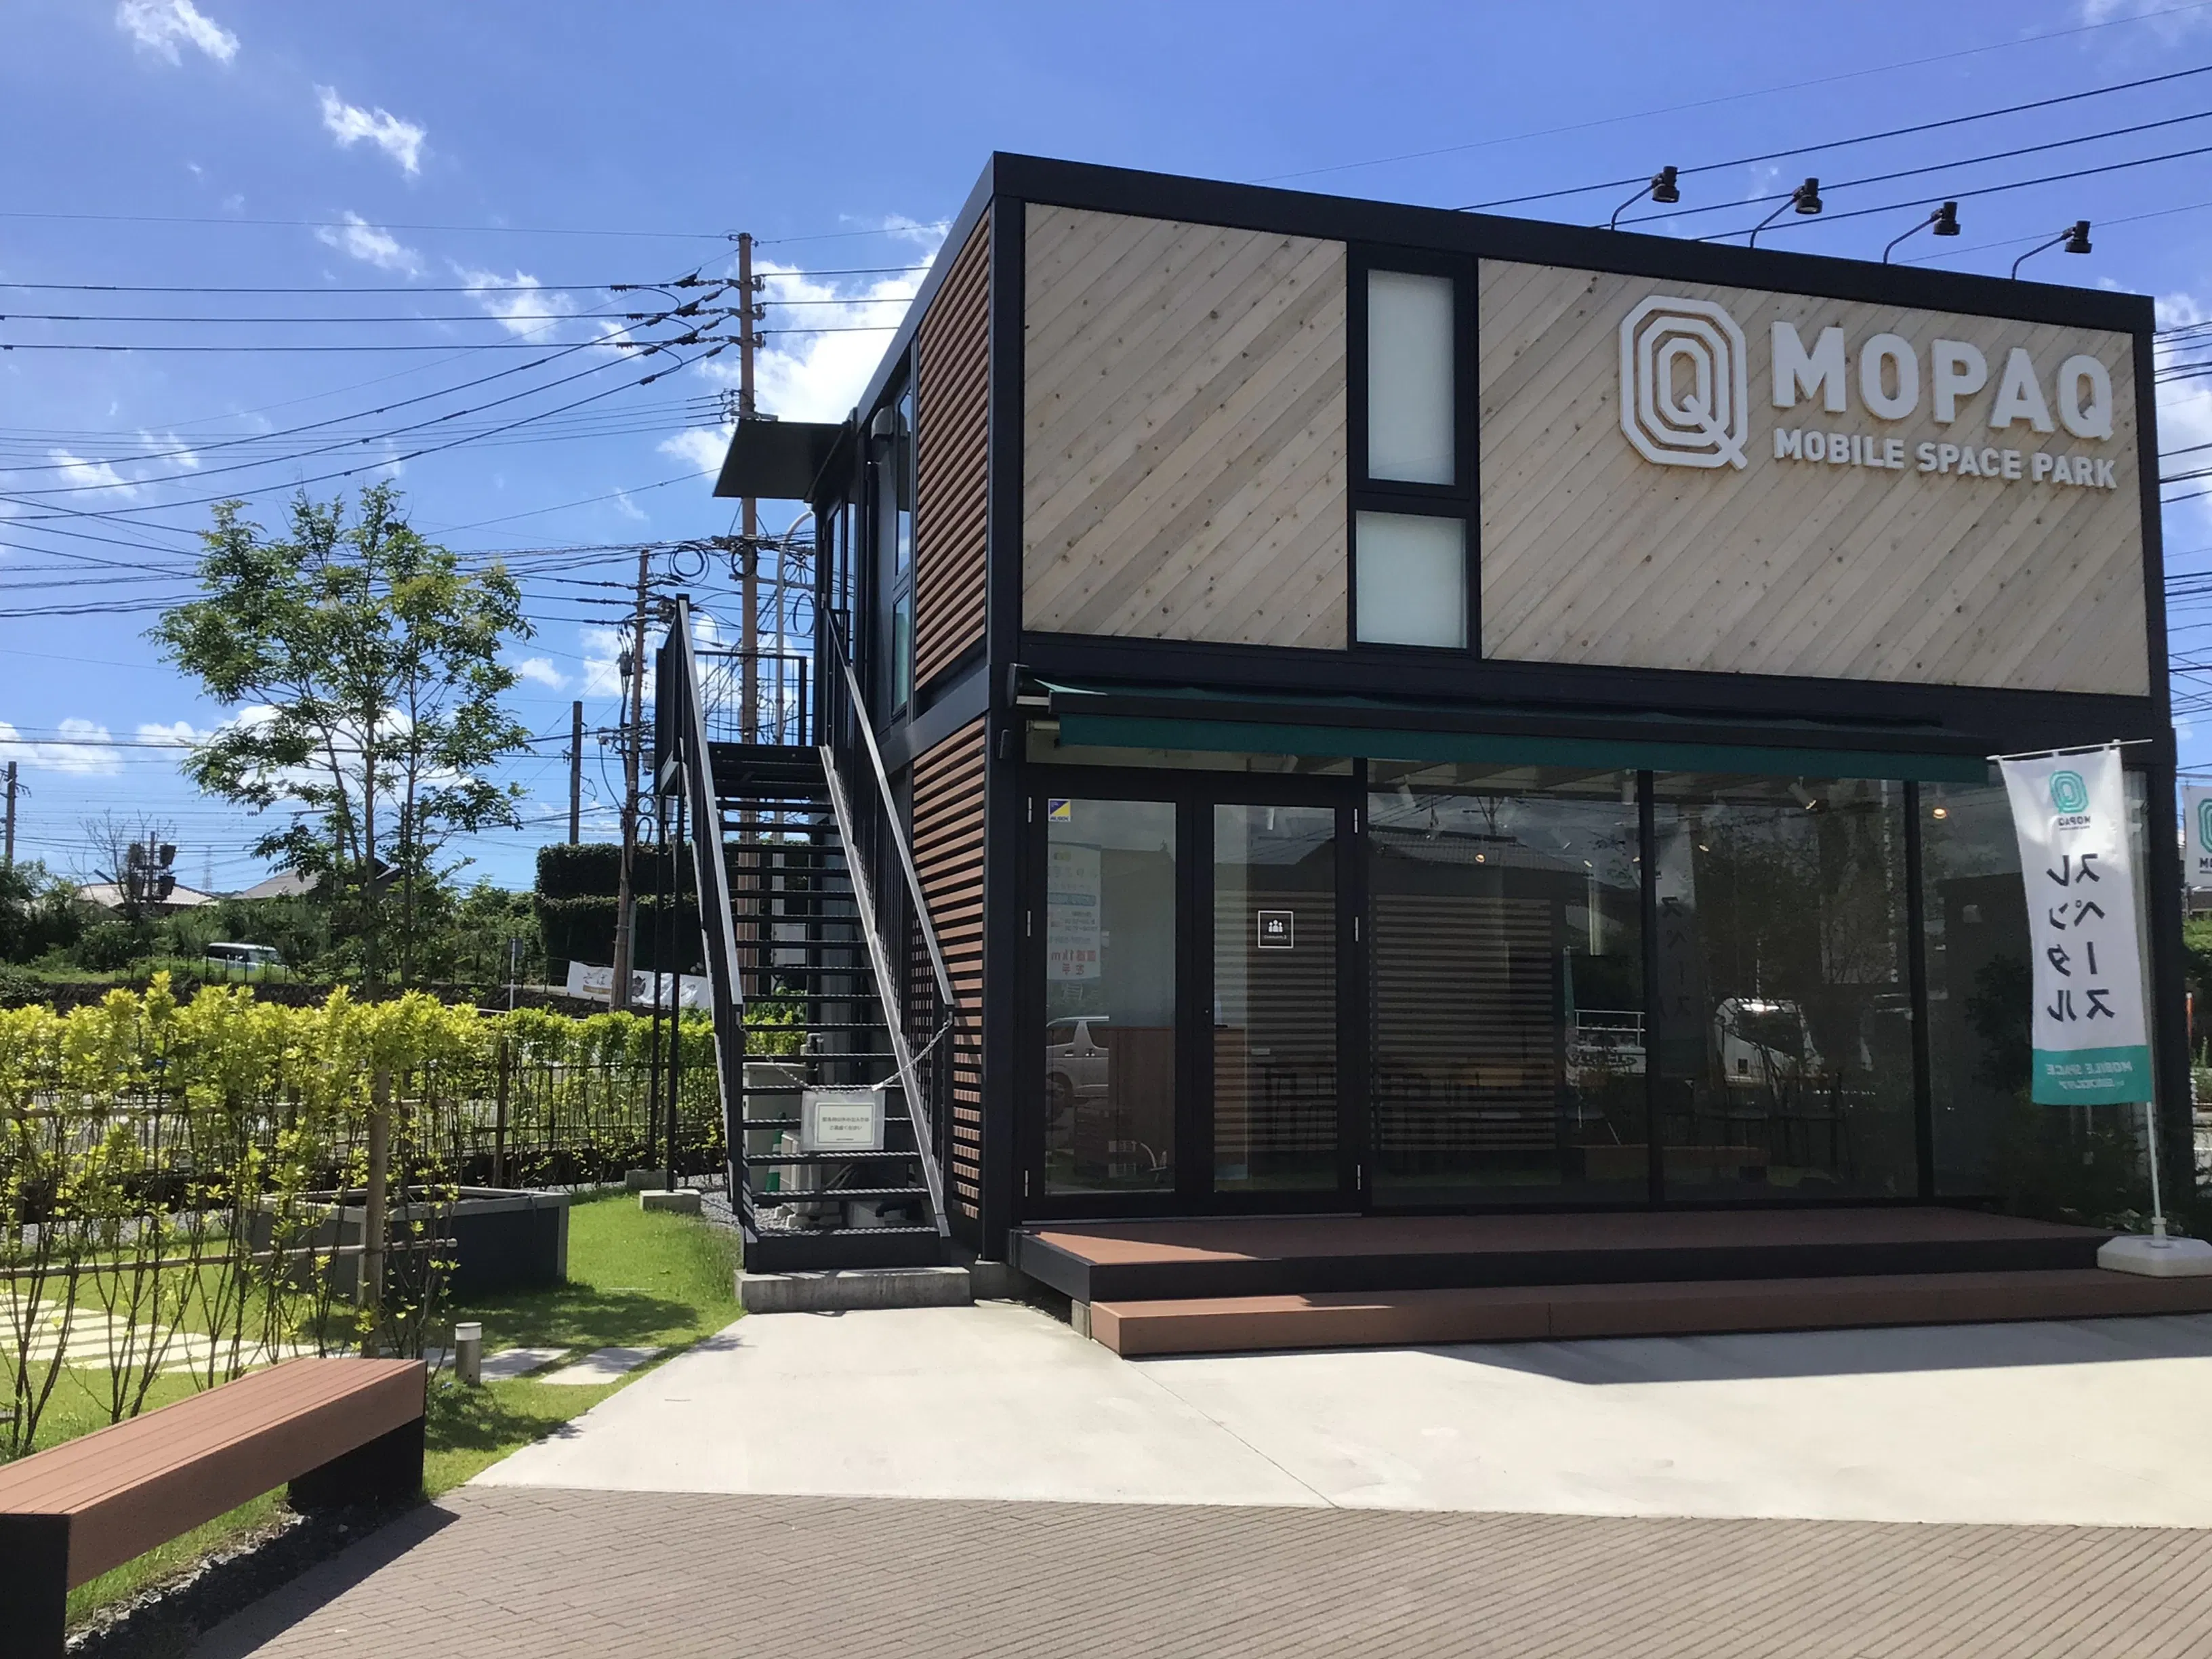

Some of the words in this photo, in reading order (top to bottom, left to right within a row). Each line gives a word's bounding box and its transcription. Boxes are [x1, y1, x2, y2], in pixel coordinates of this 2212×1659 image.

[1770, 321, 2114, 441] MOPAQ
[1774, 428, 1906, 470] MOBILE
[1915, 442, 2022, 480] SPACE
[2032, 452, 2118, 489] PARK
